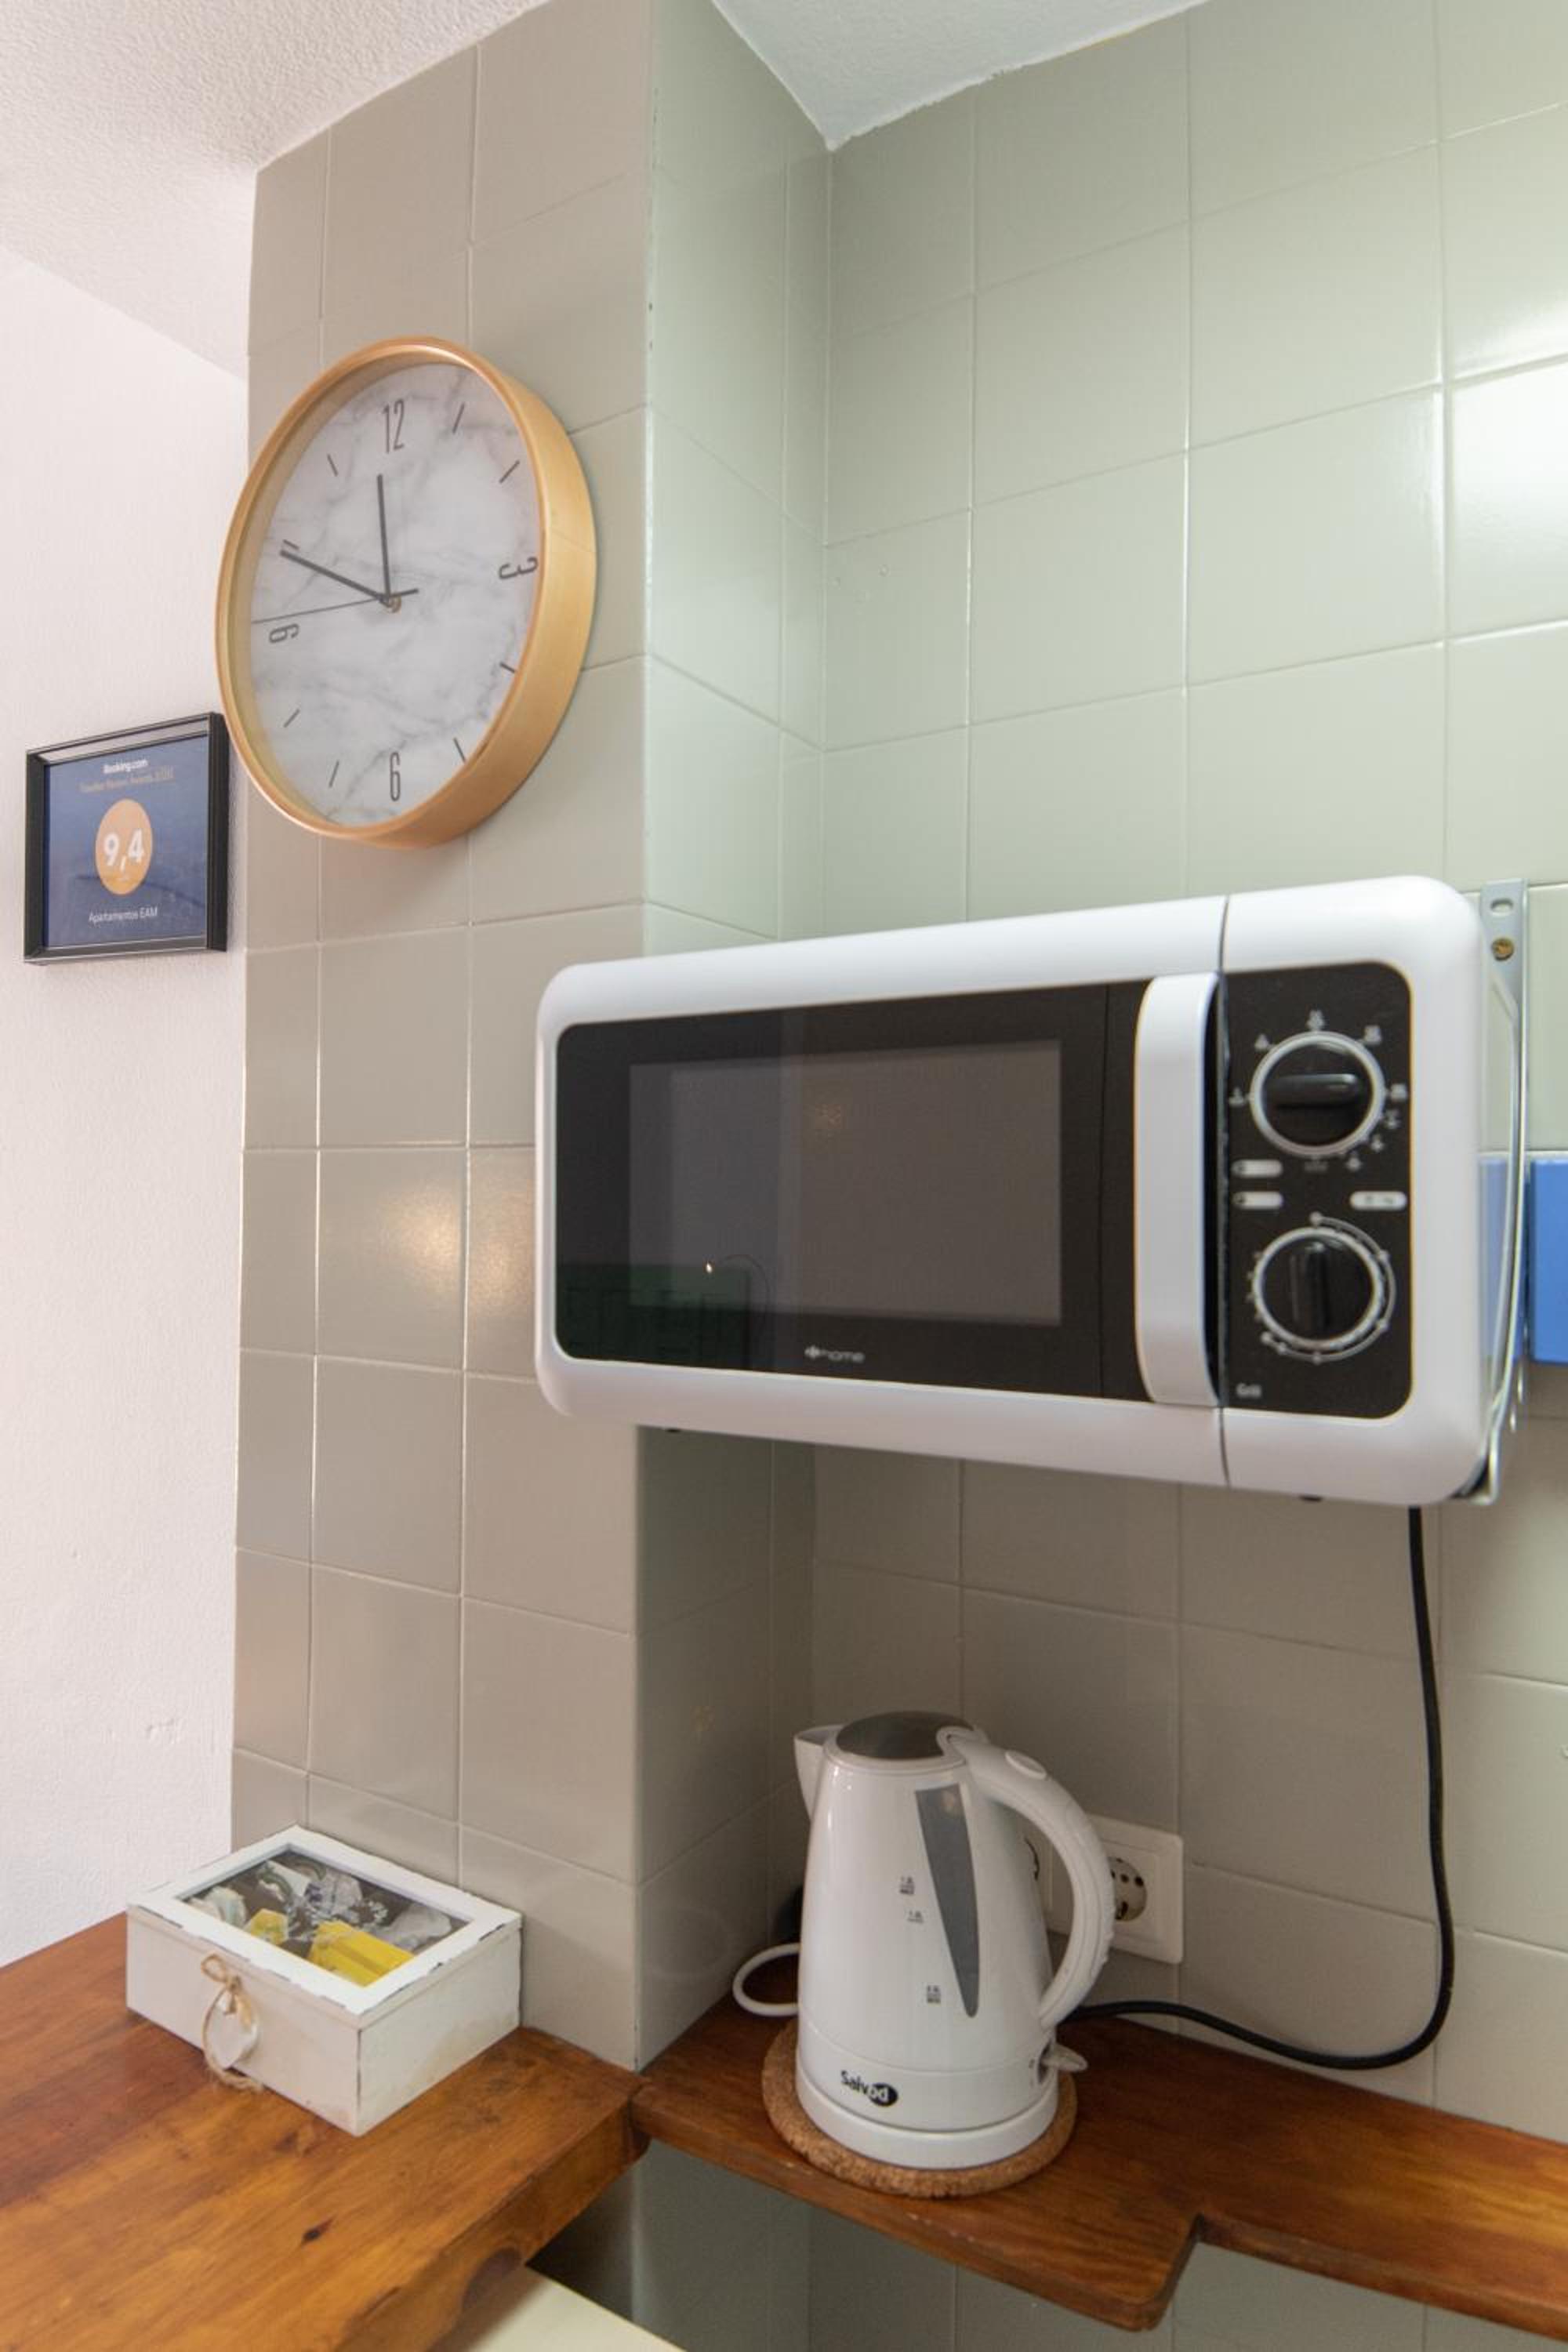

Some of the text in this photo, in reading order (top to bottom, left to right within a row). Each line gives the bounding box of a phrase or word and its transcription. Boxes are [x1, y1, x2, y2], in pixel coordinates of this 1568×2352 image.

[382, 398, 405, 454] 12
[498, 556, 539, 582] 3
[390, 752, 401, 802] 6
[103, 829, 145, 872] 9,4
